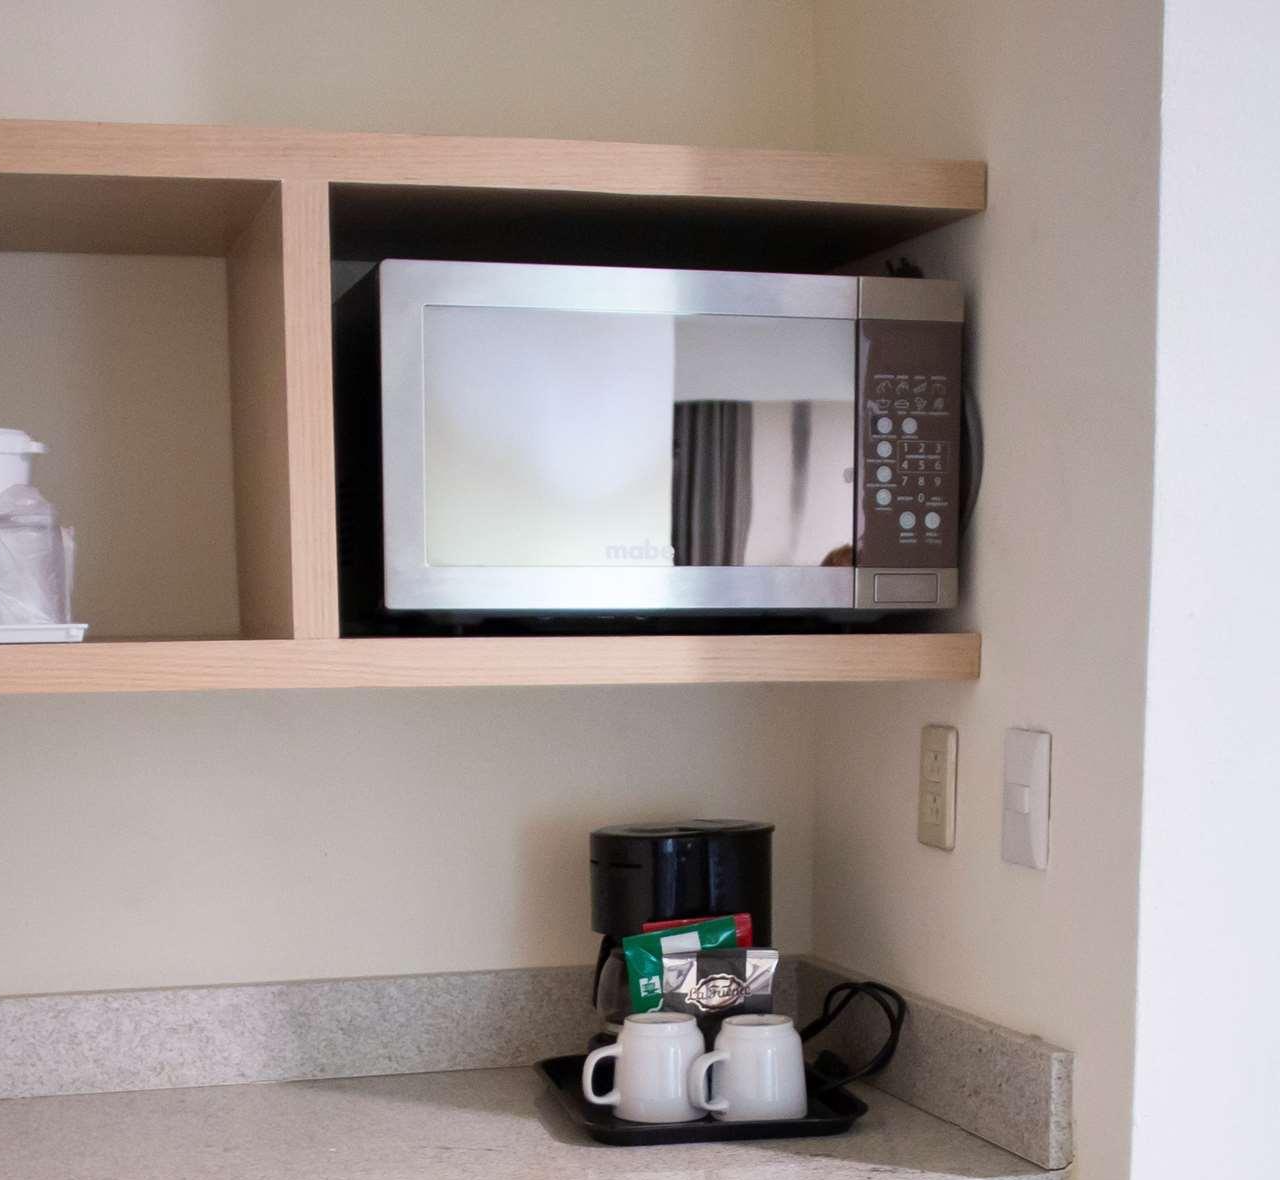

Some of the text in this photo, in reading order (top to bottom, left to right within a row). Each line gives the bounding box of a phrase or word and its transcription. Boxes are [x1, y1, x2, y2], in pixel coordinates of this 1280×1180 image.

[904, 443, 909, 452] 1
[919, 443, 925, 452] 2
[902, 460, 942, 470] 4 5 6
[902, 476, 908, 486] 7
[918, 476, 925, 486] 8
[934, 477, 941, 486] 9
[918, 493, 925, 503] 0
[605, 538, 675, 560] mabe
